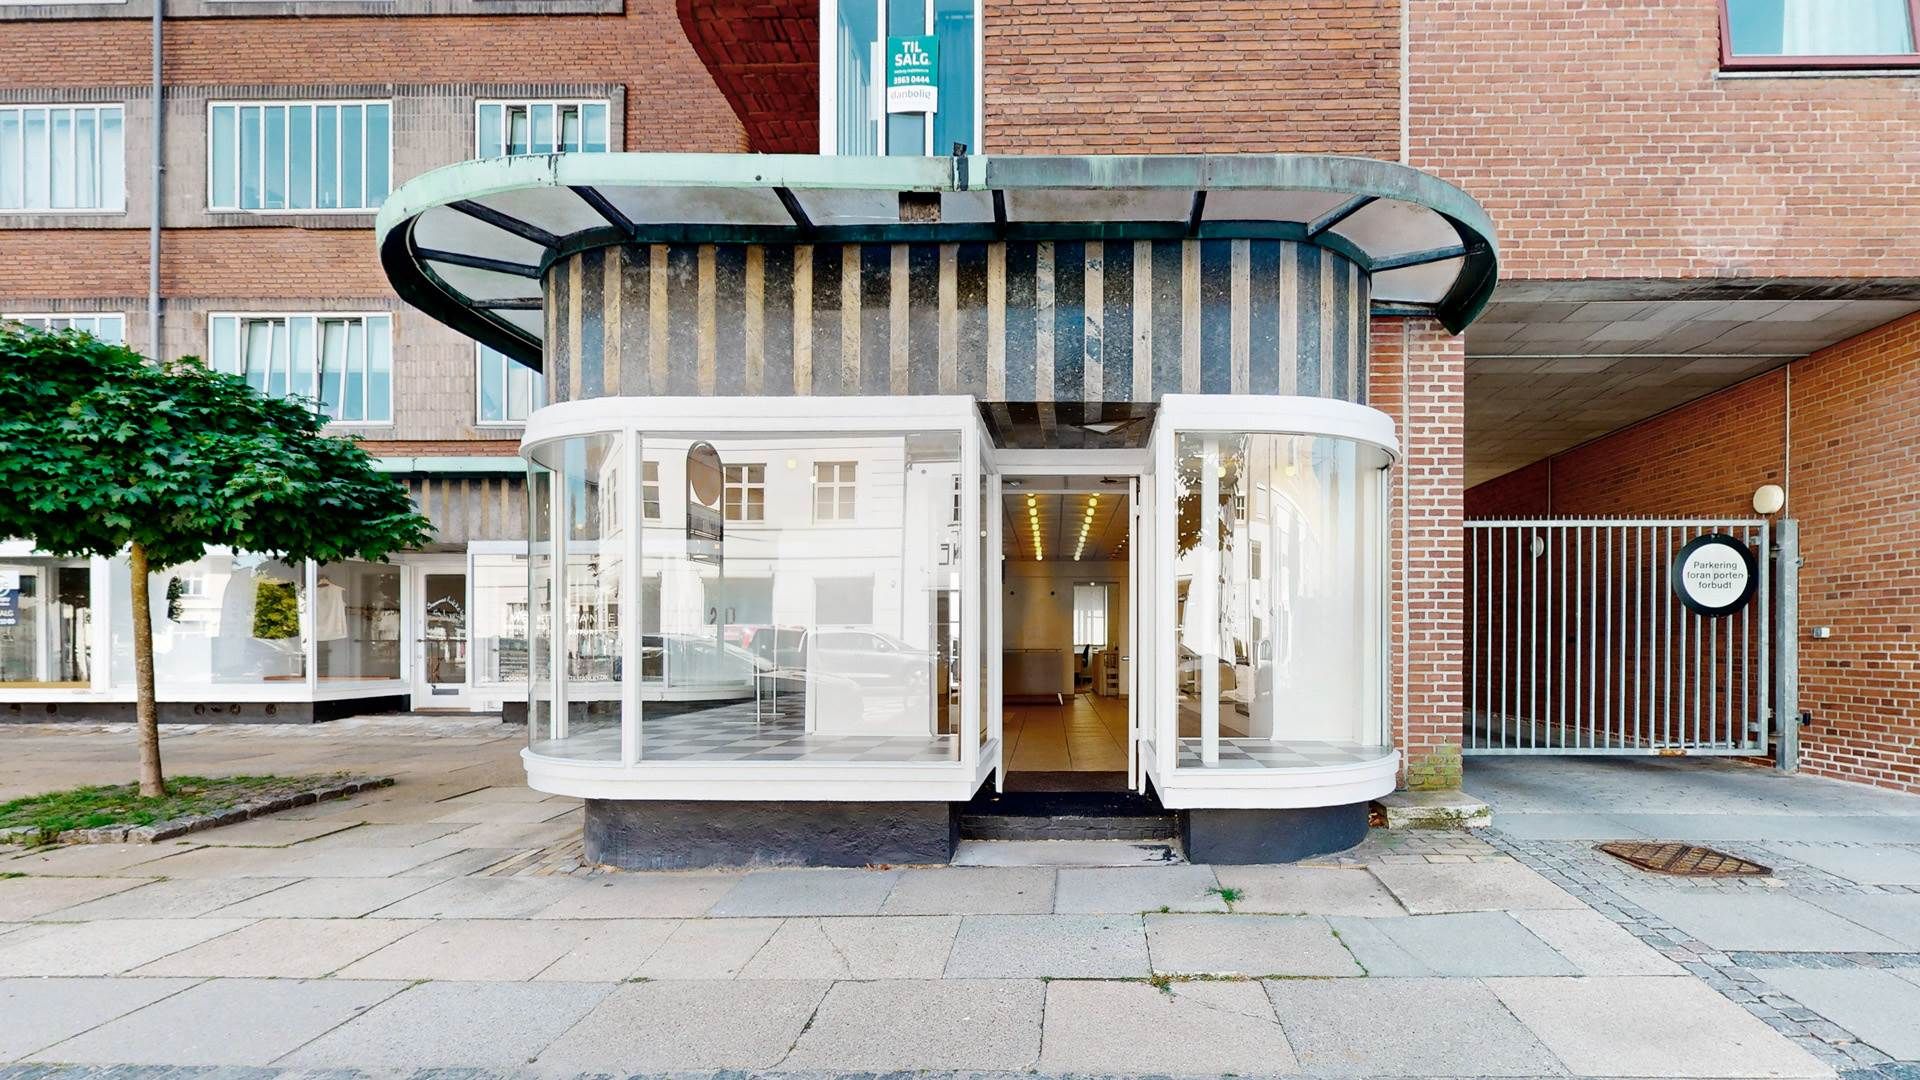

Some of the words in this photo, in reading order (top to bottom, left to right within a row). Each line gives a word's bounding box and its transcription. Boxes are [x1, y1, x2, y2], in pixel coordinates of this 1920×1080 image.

[902, 41, 922, 53] TIL
[1693, 561, 1738, 571] Parkering
[1687, 571, 1711, 579] foran
[1713, 571, 1744, 580] porten
[1698, 581, 1732, 589] forbudt
